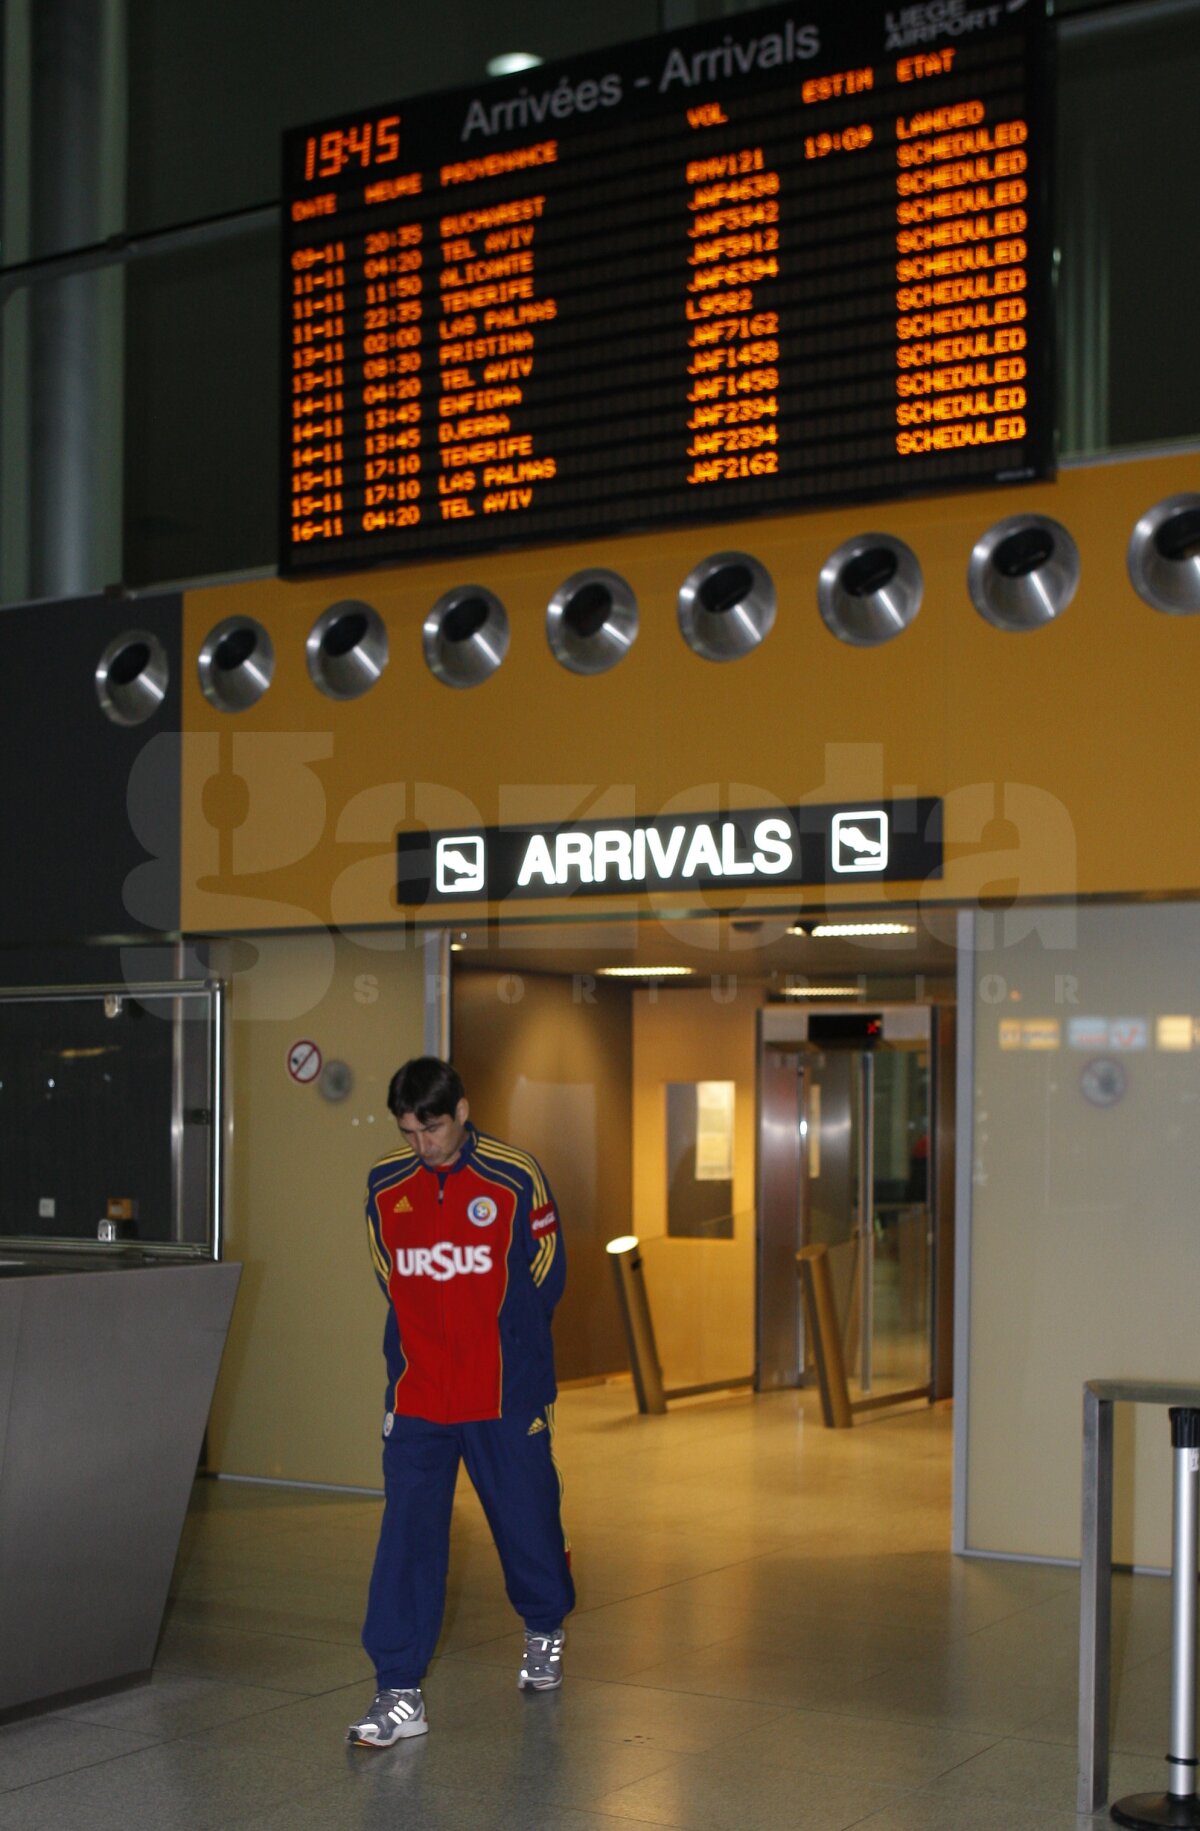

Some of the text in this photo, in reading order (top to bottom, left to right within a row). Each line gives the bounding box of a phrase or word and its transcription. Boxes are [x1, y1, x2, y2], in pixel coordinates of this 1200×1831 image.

[460, 72, 623, 142] Arrivées
[659, 19, 820, 94] Arrivals
[884, 5, 1003, 52] AIRPORT
[293, 194, 335, 221] DATE
[365, 174, 421, 203] HEURE
[441, 141, 556, 185] PROVENANCE
[687, 104, 727, 127] VOL
[896, 49, 954, 82] ETAT
[305, 116, 400, 181] 19:45
[896, 101, 984, 139] LANDED
[294, 293, 344, 319] 11-11
[367, 275, 422, 304] 11:50
[440, 251, 533, 287] ALICANTE
[897, 150, 1027, 196] SCHEDULED
[294, 318, 344, 344] 11-11
[365, 300, 422, 329] 22:35
[441, 277, 533, 312] TENERIFE
[896, 180, 1027, 224] SCHEDULED
[295, 268, 344, 294] 11-11
[442, 240, 476, 261] TEL
[485, 226, 534, 252] AVIV
[897, 121, 1027, 167] SCHEDULED
[293, 393, 343, 418] 14-11
[363, 377, 421, 404] 04:20
[441, 368, 475, 390] TEL
[483, 357, 533, 382] AVIV
[896, 268, 1027, 311] SCHEDULED
[294, 343, 344, 368] 13-11
[364, 327, 421, 354] 02:00
[439, 315, 477, 339] LAS
[484, 299, 557, 330] PALMAS
[896, 209, 1027, 253] SCHEDULED
[294, 368, 343, 393] 13-11
[439, 331, 534, 364] PRISTINA
[896, 238, 1027, 282] SCHEDULED
[293, 417, 343, 442] 14-11
[366, 403, 421, 430] 13:45
[896, 298, 1027, 339] SCHEDULED
[293, 442, 343, 467] 14-11
[365, 428, 421, 455] 13:45
[438, 414, 510, 442] DJERBA
[896, 327, 1027, 368] SCHEDULED
[293, 467, 343, 492] 15-11
[365, 454, 421, 480] 17:10
[440, 435, 532, 467] TENERIFE
[896, 357, 1027, 397] SCHEDULED
[292, 493, 342, 517] 15-11
[365, 479, 421, 506] 17:10
[438, 471, 476, 494] LAS
[483, 458, 556, 487] PALMAS
[896, 386, 1027, 426] SCHEDULED
[292, 518, 342, 542] 16-11
[362, 505, 420, 531] 04:20
[440, 498, 475, 519] TEL
[483, 488, 532, 513] AVIV
[896, 415, 1026, 455] SCHEDULED
[517, 818, 793, 885] ARRIVALS
[396, 1241, 492, 1282] URSUS
